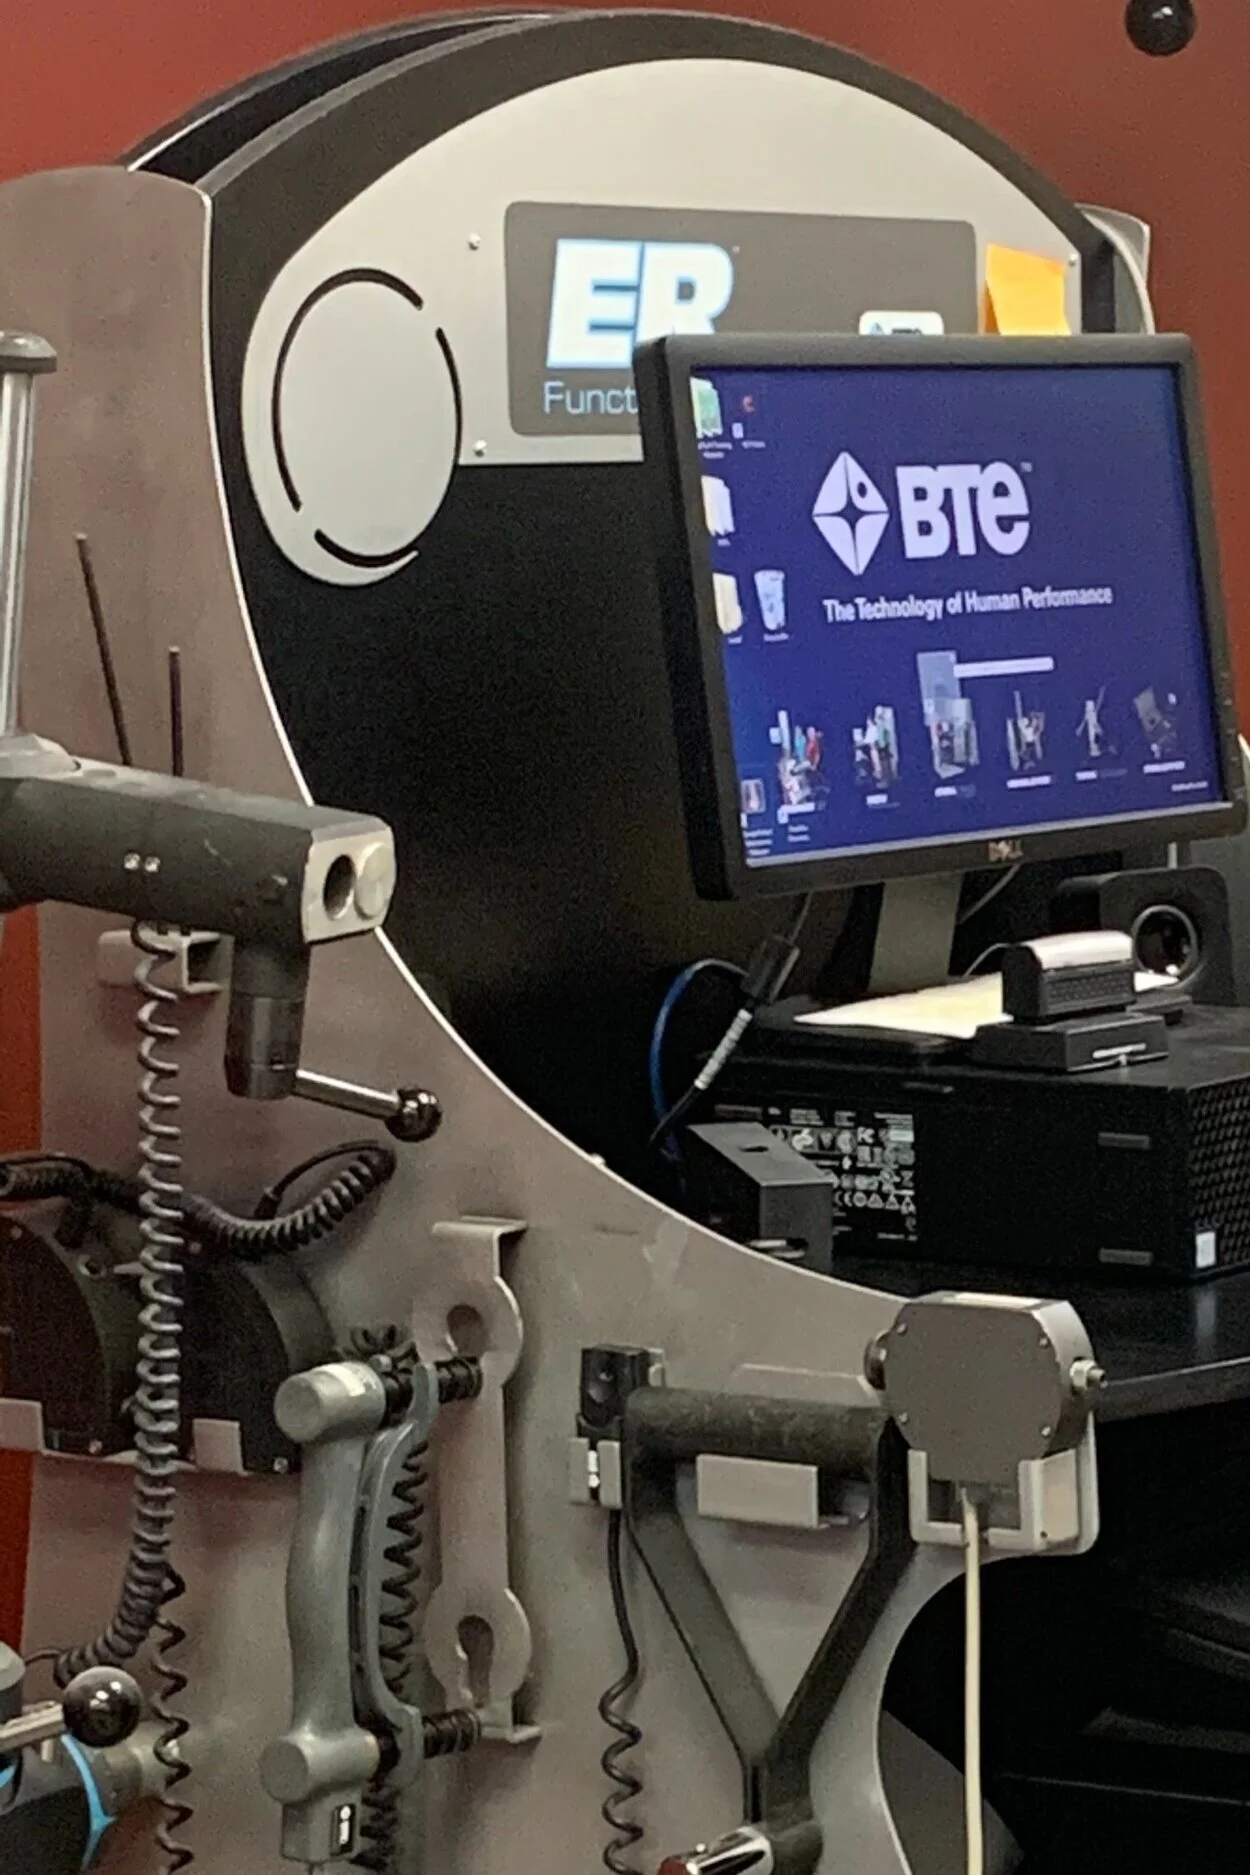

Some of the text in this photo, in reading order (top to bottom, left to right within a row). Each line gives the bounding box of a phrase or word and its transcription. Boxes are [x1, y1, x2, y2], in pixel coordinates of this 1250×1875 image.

[546, 237, 734, 369] ER
[543, 380, 639, 415] Funct
[822, 586, 1112, 622] The Technology of Human Performance
